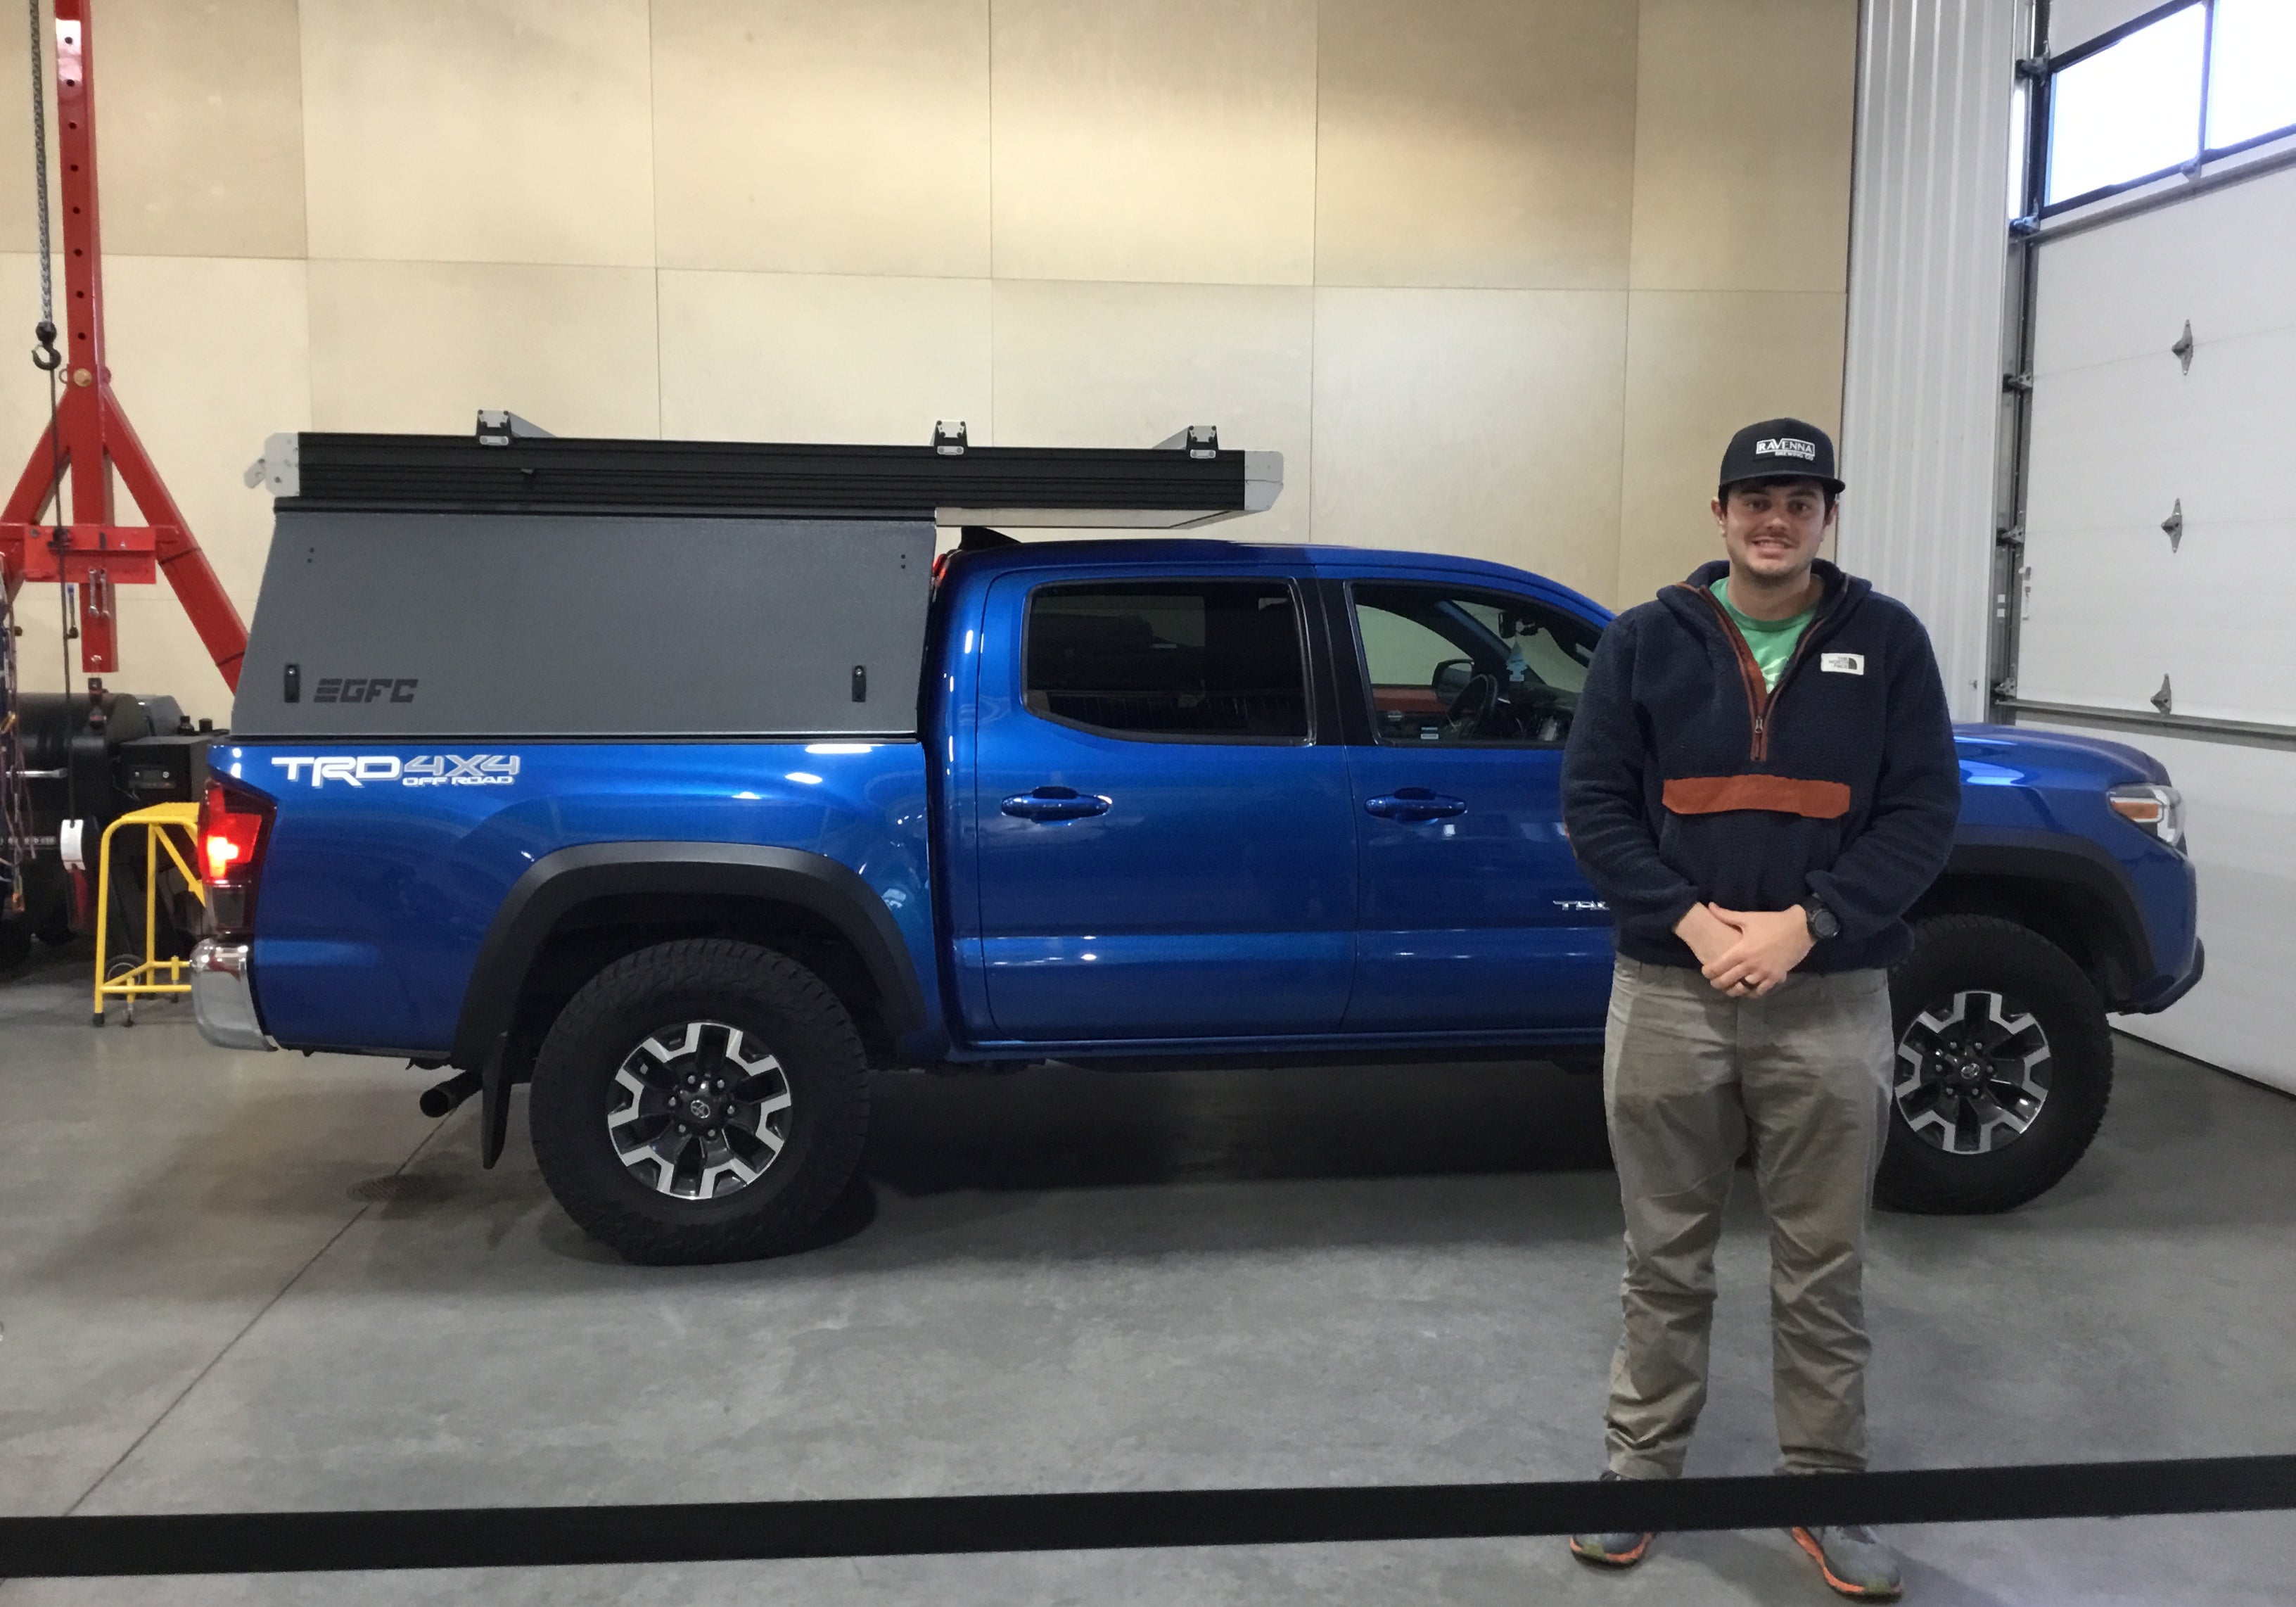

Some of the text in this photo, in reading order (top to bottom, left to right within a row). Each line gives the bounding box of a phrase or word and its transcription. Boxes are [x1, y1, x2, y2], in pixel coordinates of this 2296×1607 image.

[1758, 438, 1813, 454] RAVENNA
[271, 756, 403, 789] TRD
[402, 775, 516, 787] OFF ROAD
